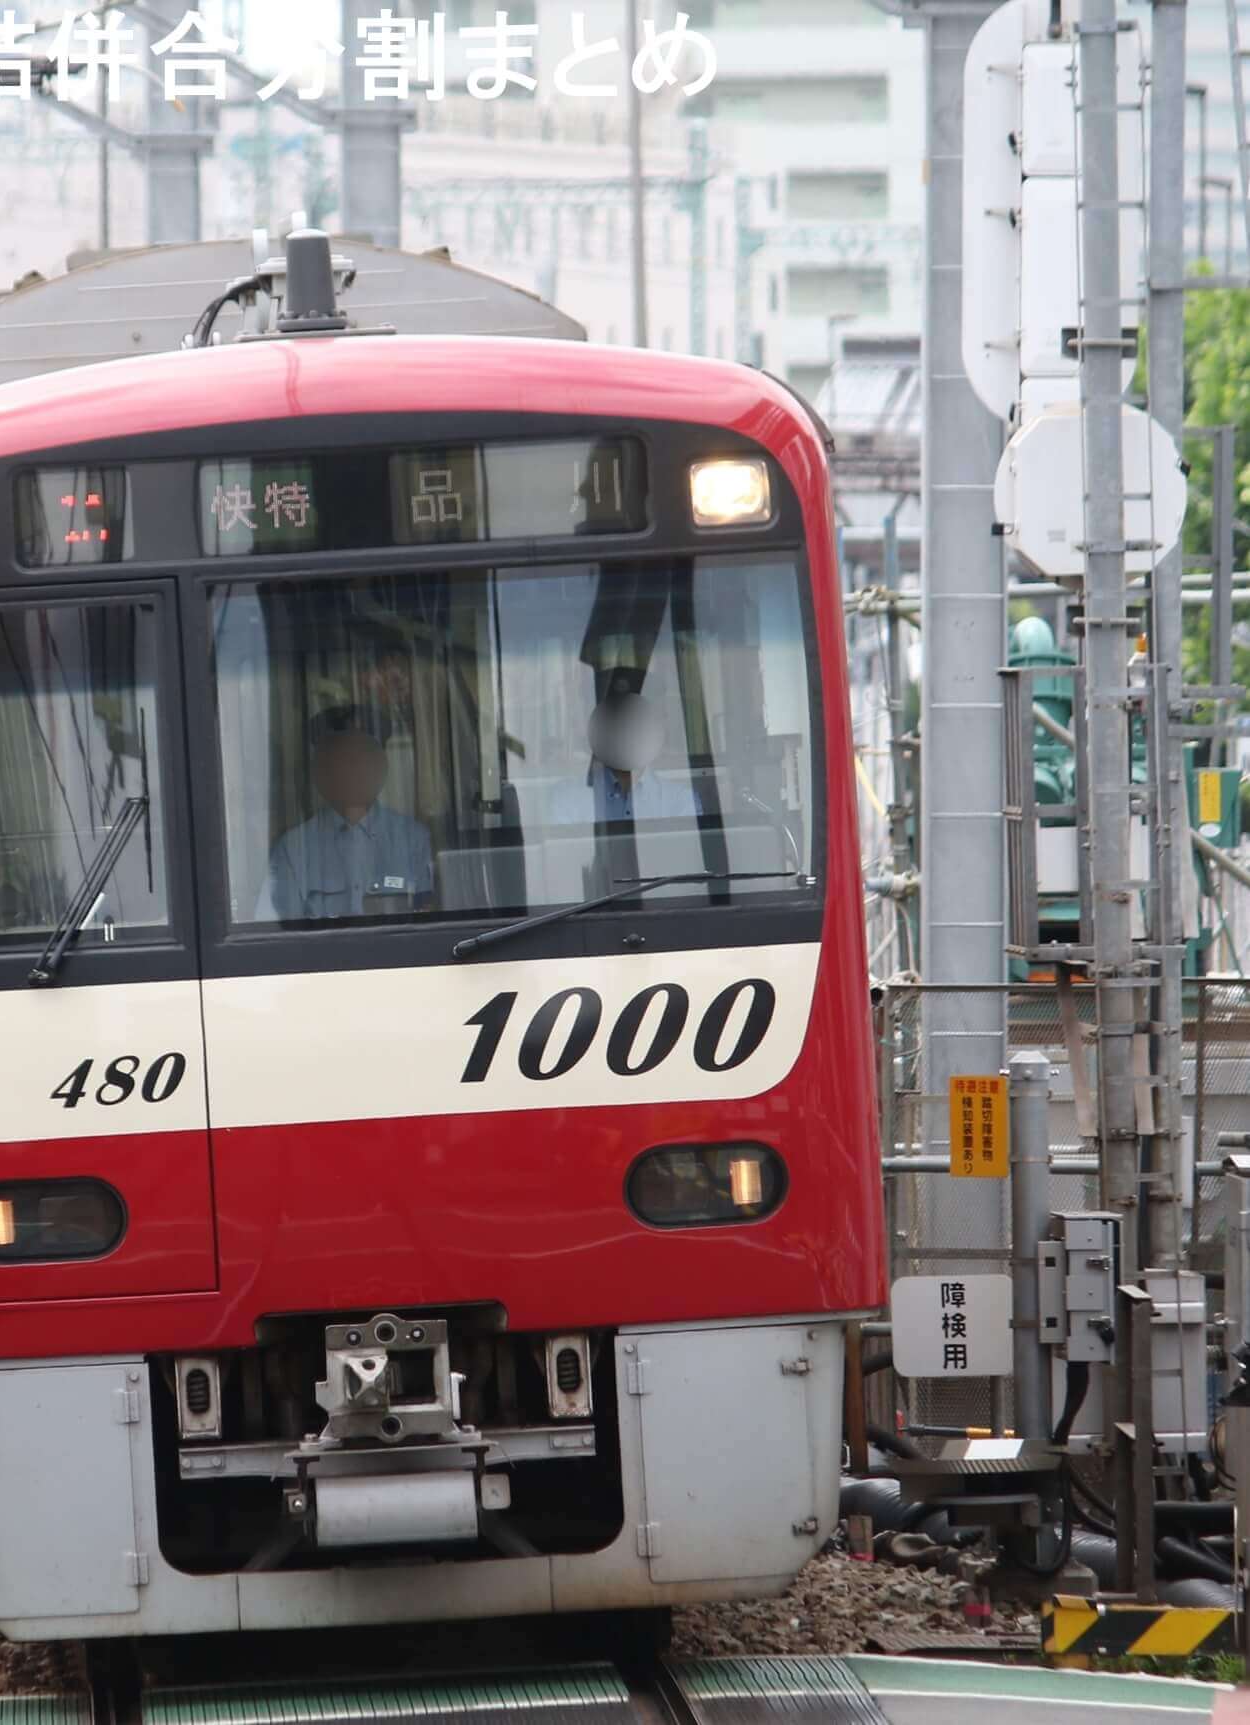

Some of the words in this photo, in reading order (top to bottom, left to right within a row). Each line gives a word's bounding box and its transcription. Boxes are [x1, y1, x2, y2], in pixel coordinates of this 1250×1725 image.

[211, 481, 310, 531] 快特
[411, 457, 621, 523] 品川
[460, 978, 776, 1083] 1000
[50, 1052, 186, 1109] 480
[941, 1282, 967, 1369] 障検用
